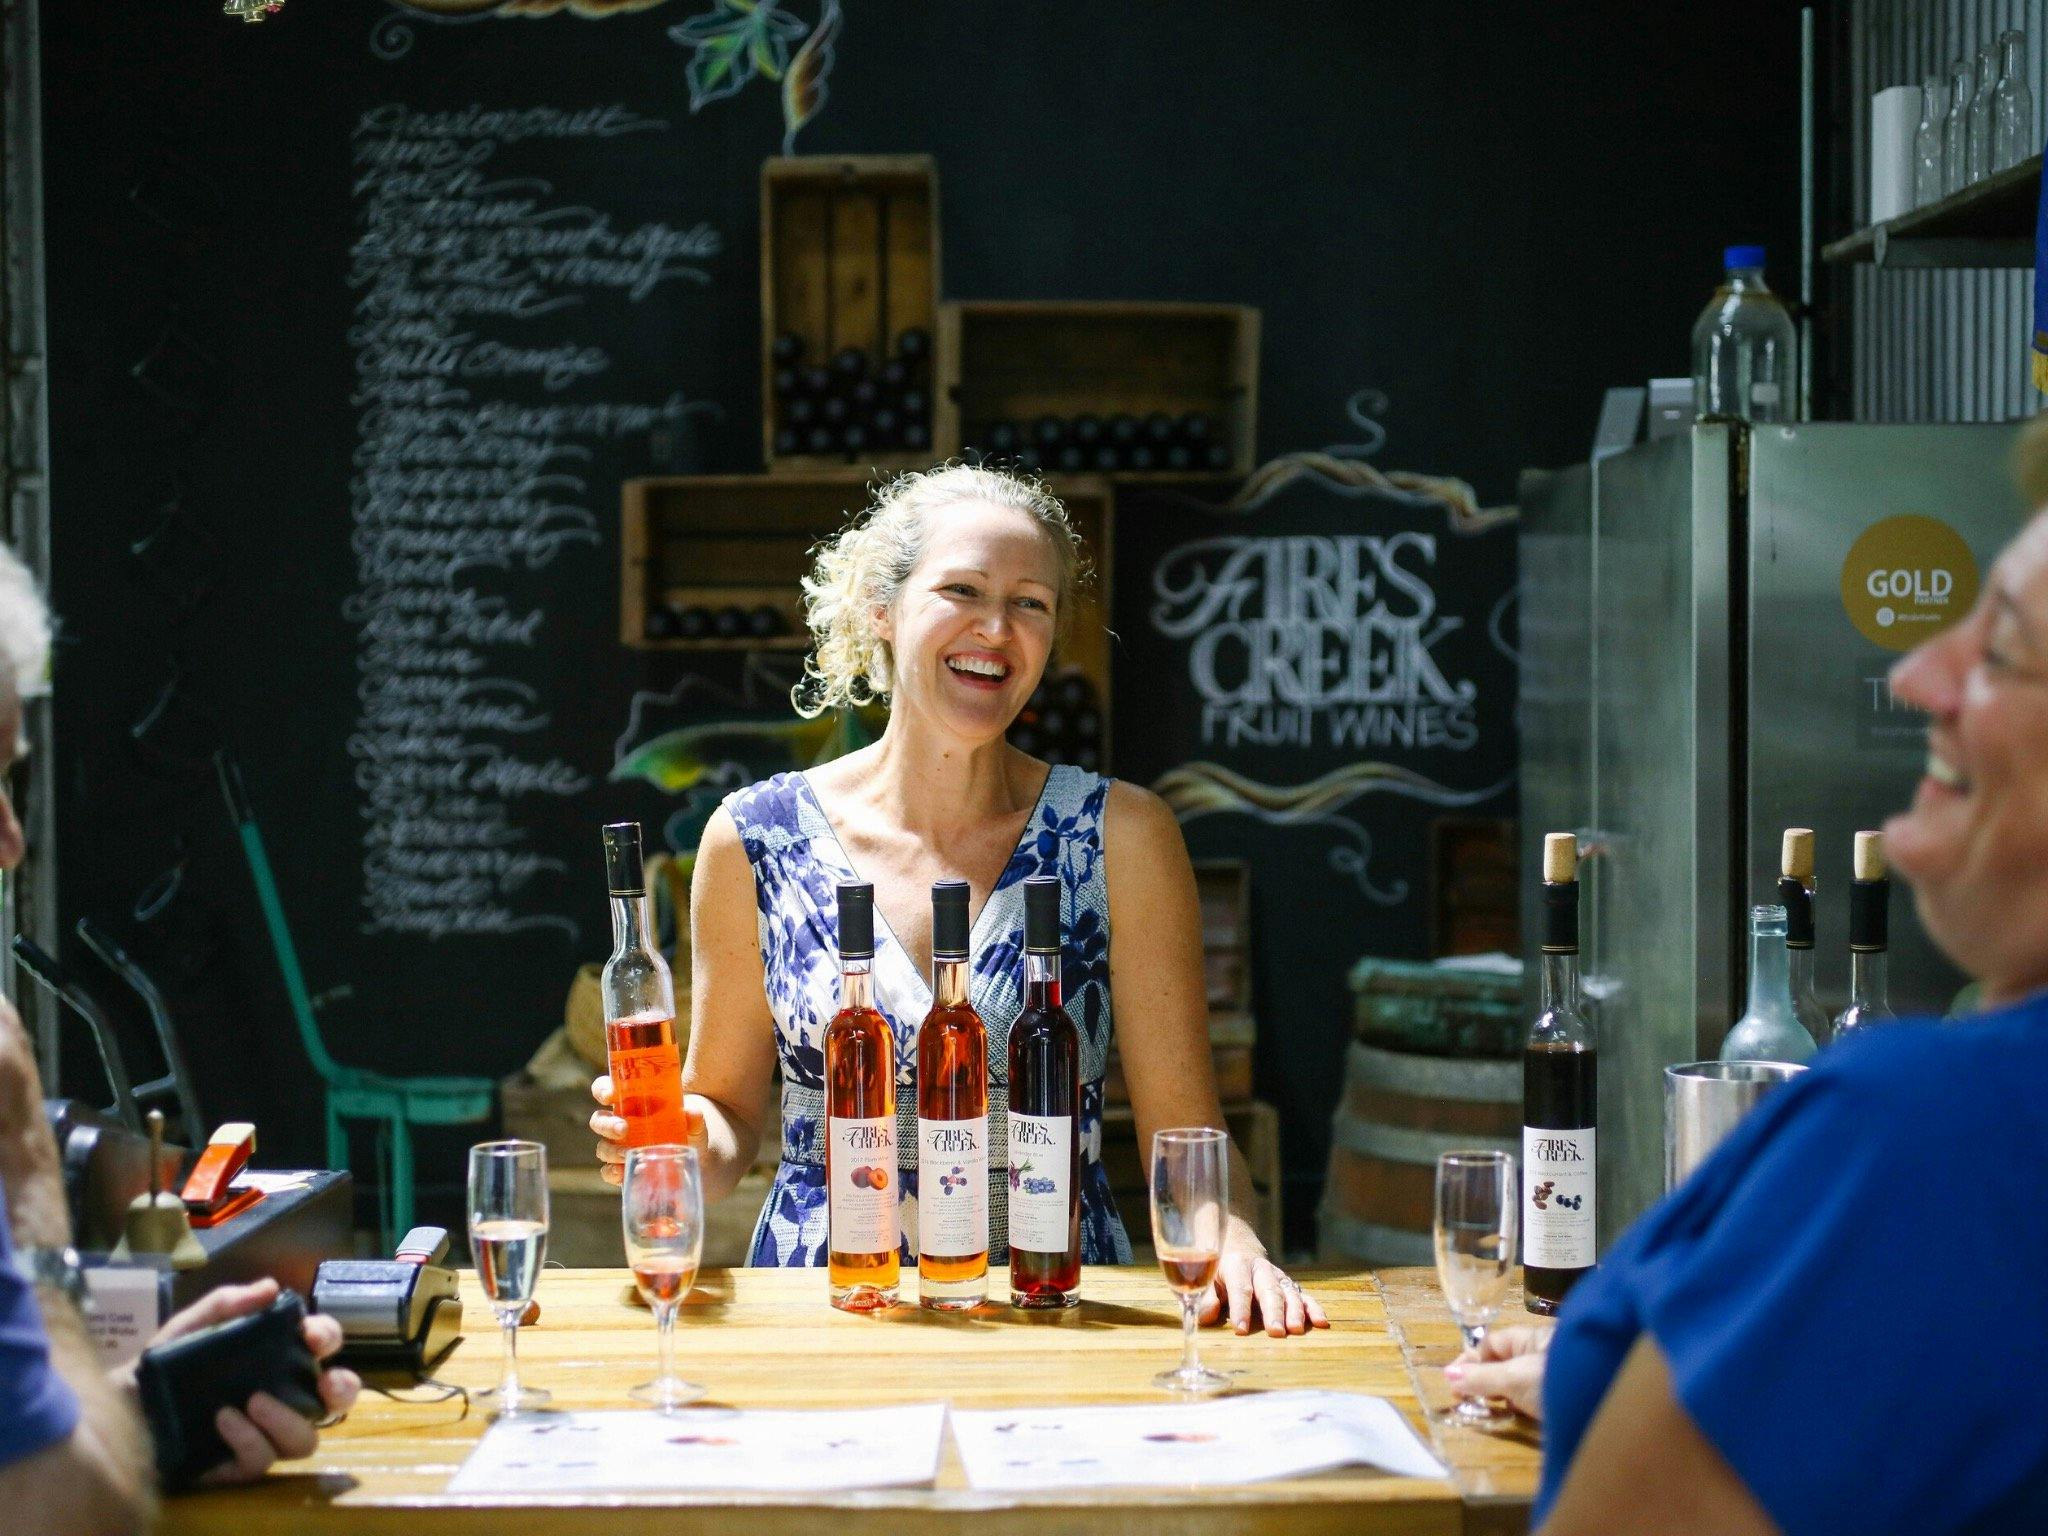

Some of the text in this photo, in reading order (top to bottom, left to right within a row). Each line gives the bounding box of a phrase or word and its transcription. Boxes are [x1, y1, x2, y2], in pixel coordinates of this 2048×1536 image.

[1866, 568, 1953, 599] GOLD
[1189, 614, 1478, 706] CREEK
[1330, 700, 1480, 750] WINES
[850, 1137, 894, 1149] CREEK
[935, 1139, 980, 1152] CREEK
[1537, 1149, 1585, 1162] CREEK
